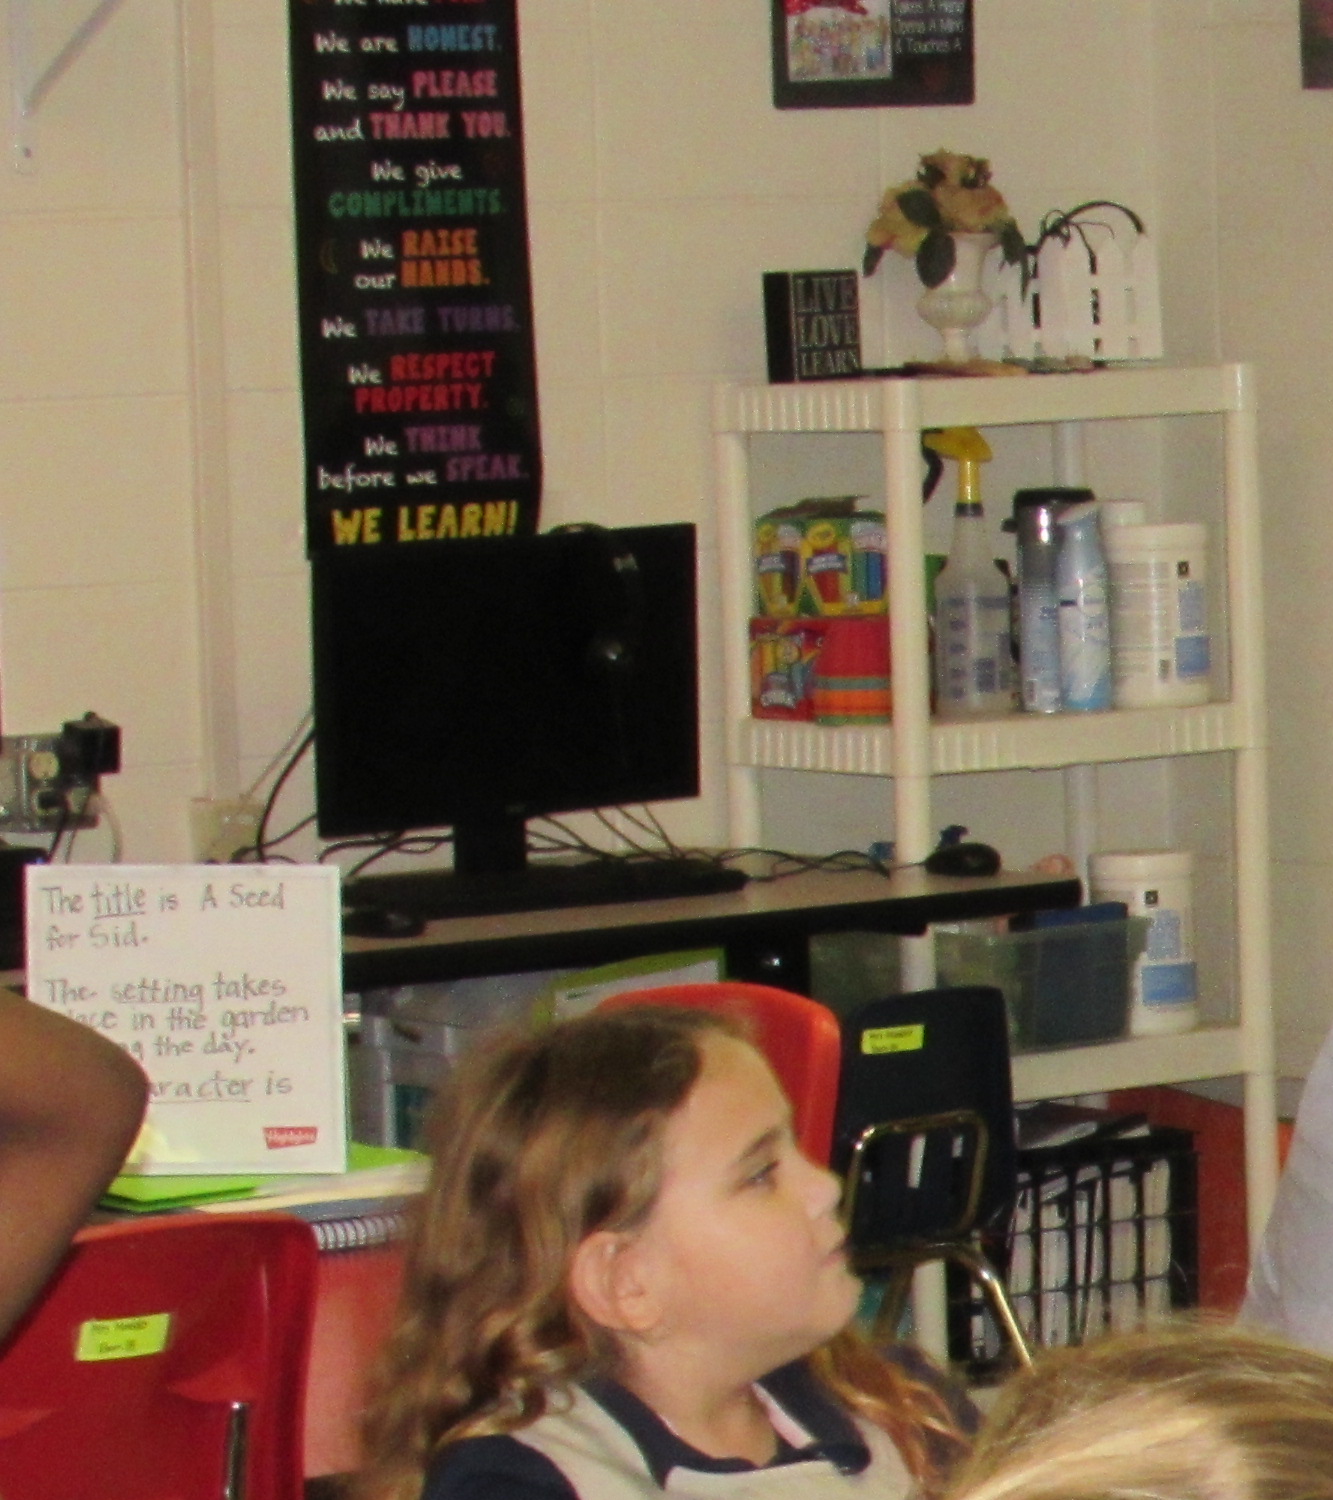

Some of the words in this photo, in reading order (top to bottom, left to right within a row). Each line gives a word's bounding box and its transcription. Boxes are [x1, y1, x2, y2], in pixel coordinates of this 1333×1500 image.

[314, 31, 351, 54] We
[360, 36, 400, 53] are
[321, 78, 358, 101] We
[367, 82, 406, 112] say
[411, 69, 498, 98] PLEASE
[313, 118, 366, 142] and
[369, 111, 450, 140] THANK
[370, 158, 407, 183] We
[413, 160, 464, 189] give
[359, 238, 395, 261] We
[402, 228, 479, 257] RAISE
[354, 272, 398, 290] our
[402, 258, 491, 288] HANDS.
[796, 277, 858, 312] LIVE
[320, 316, 358, 339] We
[365, 307, 426, 336] TAKE
[797, 314, 860, 347] LOVE
[347, 363, 383, 385] We
[390, 351, 496, 382] RESPECT
[799, 350, 860, 376] LEARN
[364, 435, 399, 458] We
[405, 425, 483, 452] THINK
[317, 461, 397, 494] before
[406, 469, 439, 485] we
[331, 507, 382, 545] WE
[397, 501, 519, 543] LEARN!
[39, 886, 84, 915] The
[92, 883, 147, 914] title
[158, 884, 180, 913] is
[200, 883, 218, 912] A
[230, 881, 286, 911] Seed
[46, 925, 80, 950] for
[88, 921, 148, 950] Sid.
[111, 977, 204, 1012] setting
[213, 972, 288, 1000] takes
[131, 1009, 155, 1031] in
[167, 1005, 208, 1031] the
[220, 1000, 311, 1038] garden
[153, 1033, 195, 1056] the
[202, 1032, 256, 1063] day.
[264, 1070, 294, 1096] is
